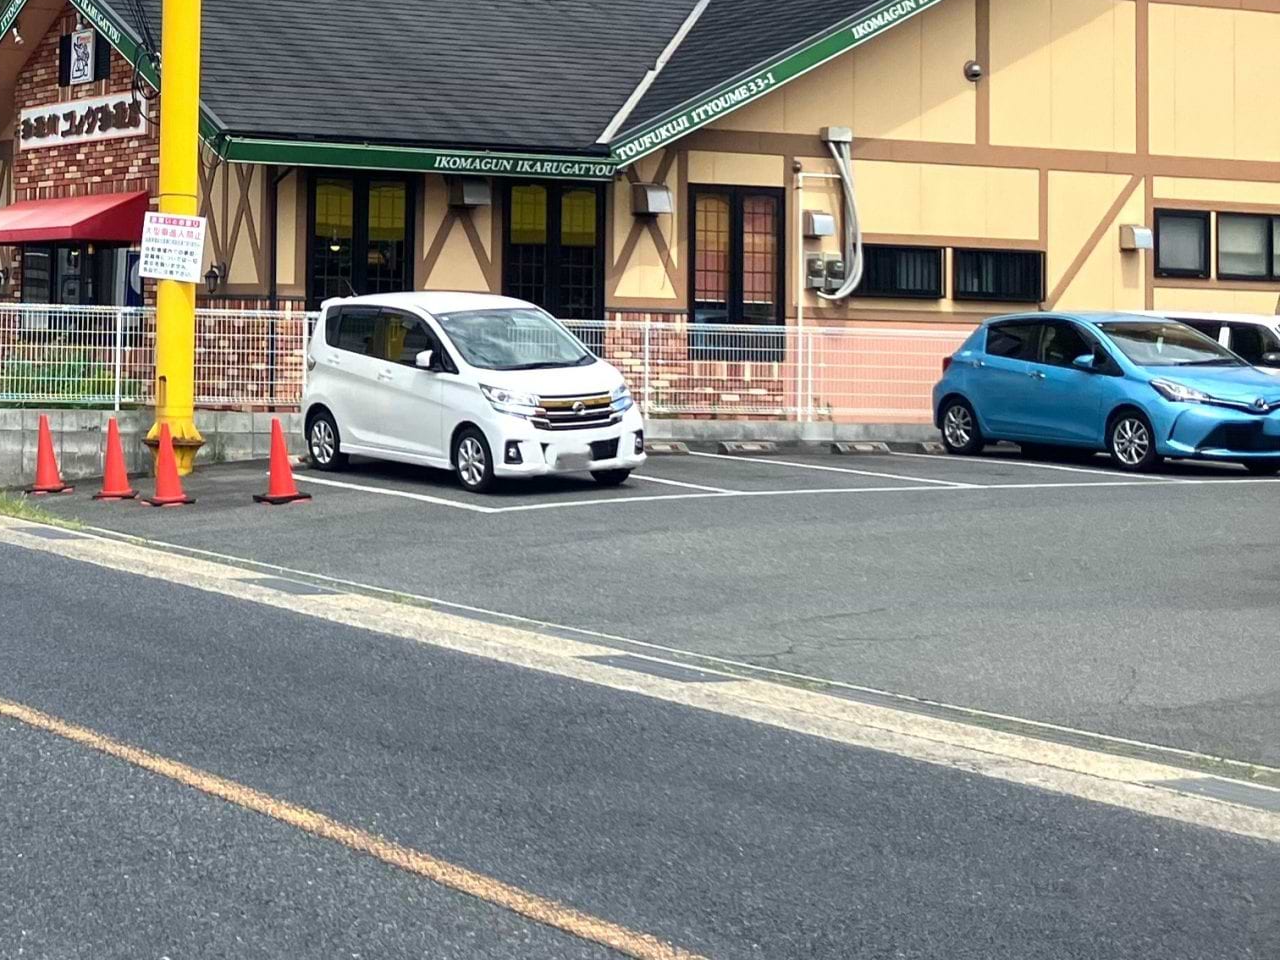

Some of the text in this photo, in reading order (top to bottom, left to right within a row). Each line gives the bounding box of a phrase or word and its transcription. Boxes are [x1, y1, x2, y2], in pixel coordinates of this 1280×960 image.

[617, 116, 690, 160] TOUFUKUJI
[433, 155, 618, 177] IKOMAGUN IKARUGATYOU
